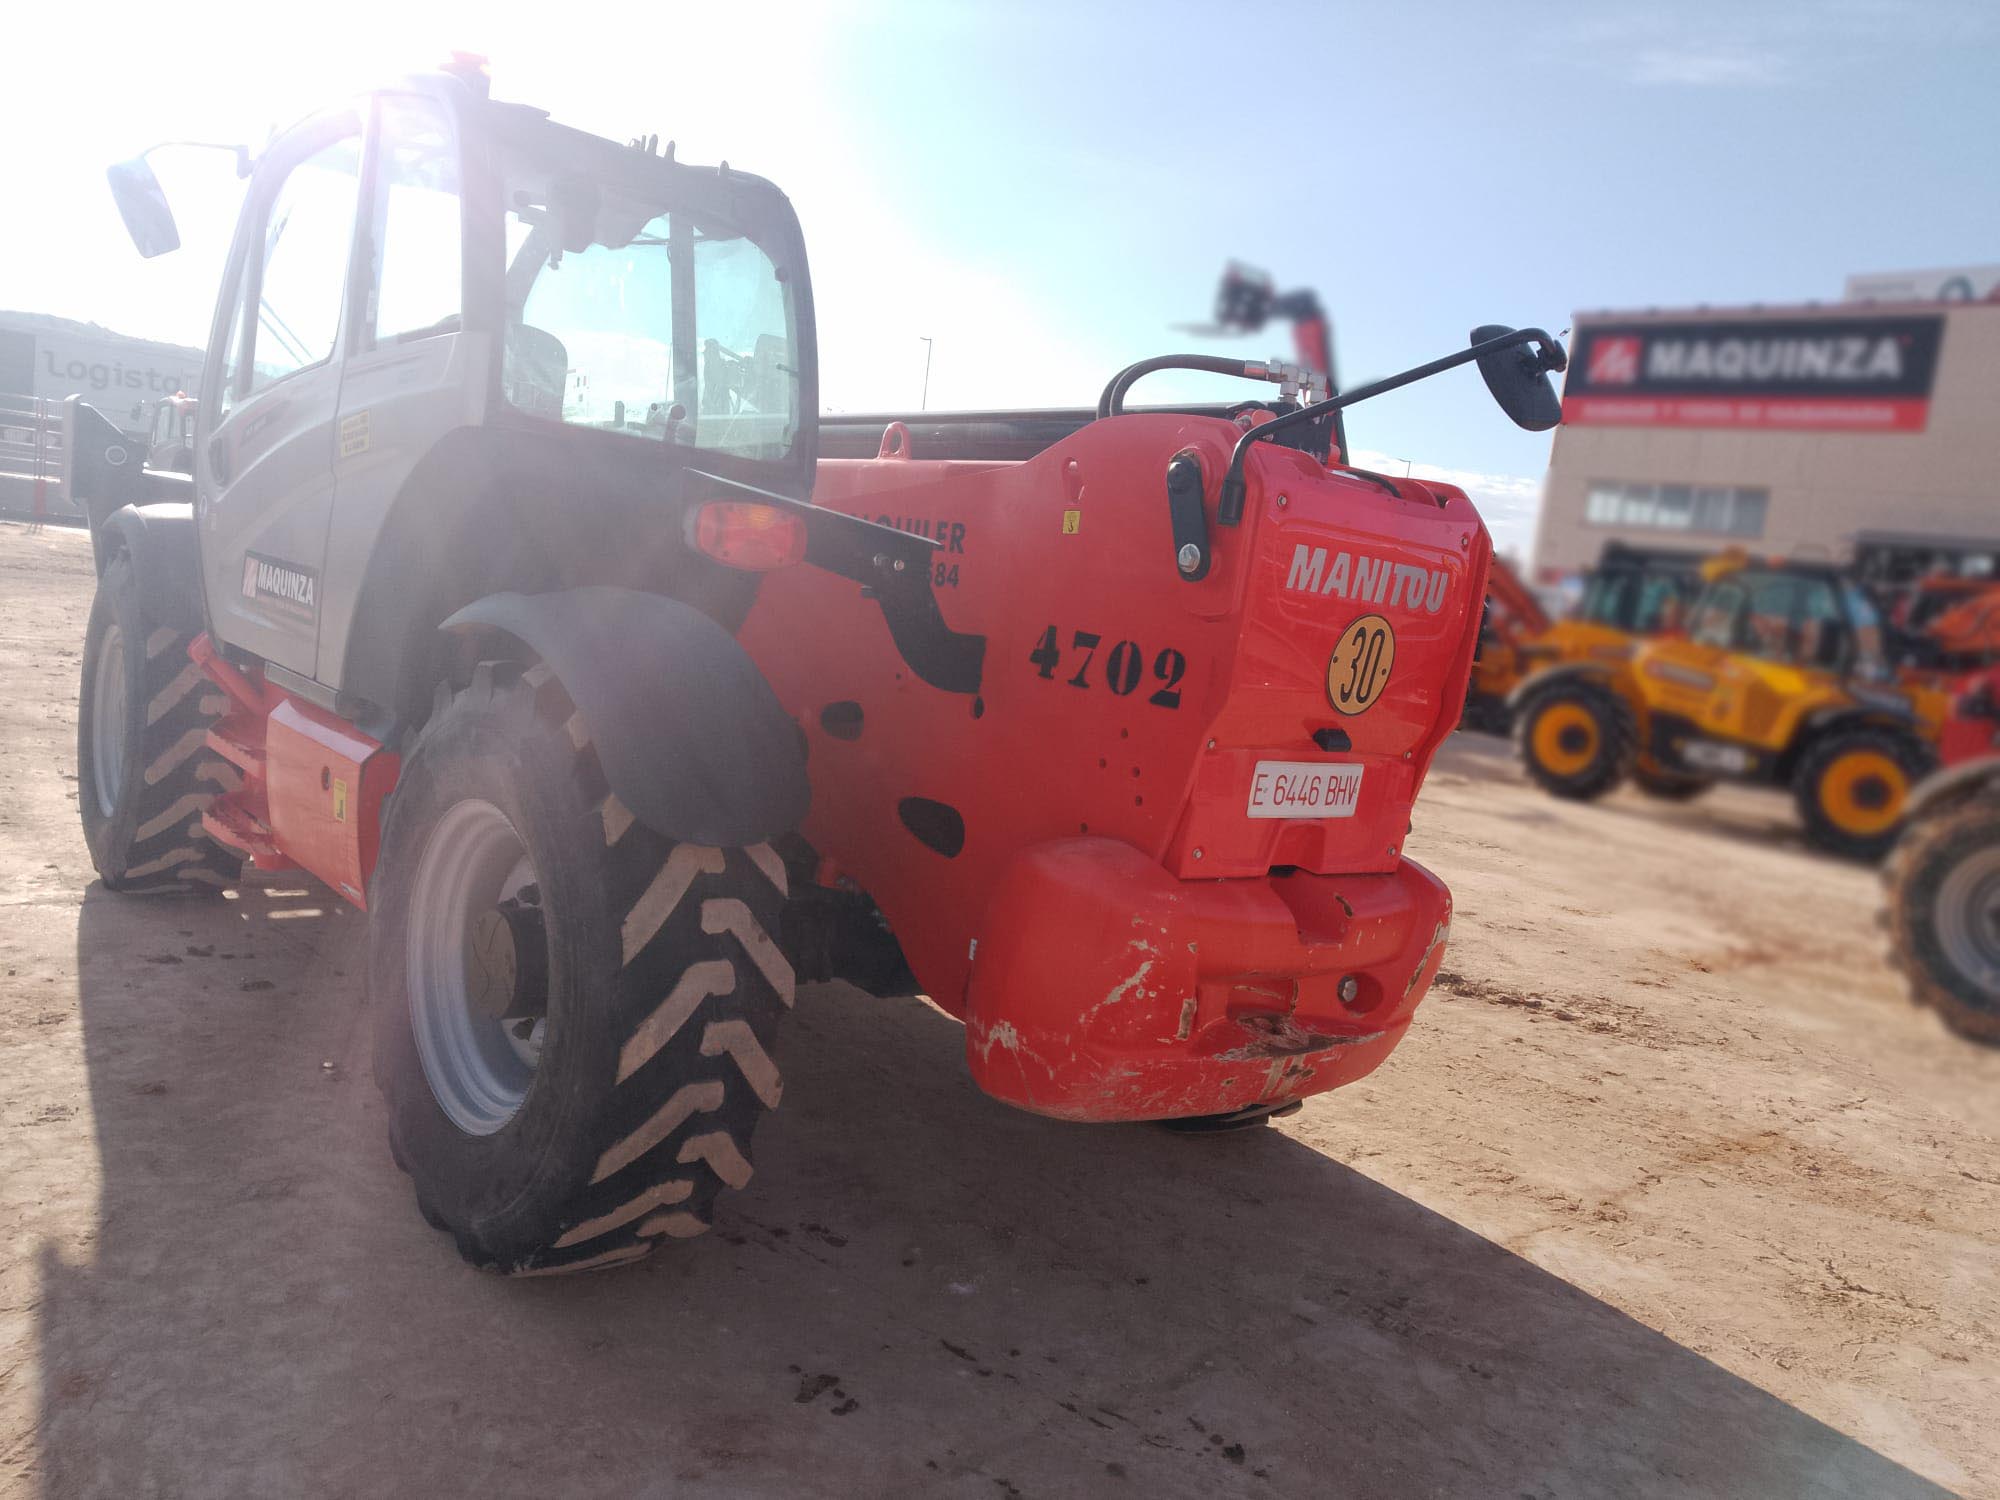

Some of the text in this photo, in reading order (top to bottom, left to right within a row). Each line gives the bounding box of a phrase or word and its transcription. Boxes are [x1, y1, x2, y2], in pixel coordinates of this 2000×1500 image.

[1650, 337, 1900, 381] MAQUINZA
[257, 562, 314, 606] MAQUINZA
[1286, 543, 1449, 614] MANITOU
[1029, 625, 1187, 710] 4702
[1340, 626, 1385, 704] 30
[1252, 773, 1359, 806] E 6446 BHV
